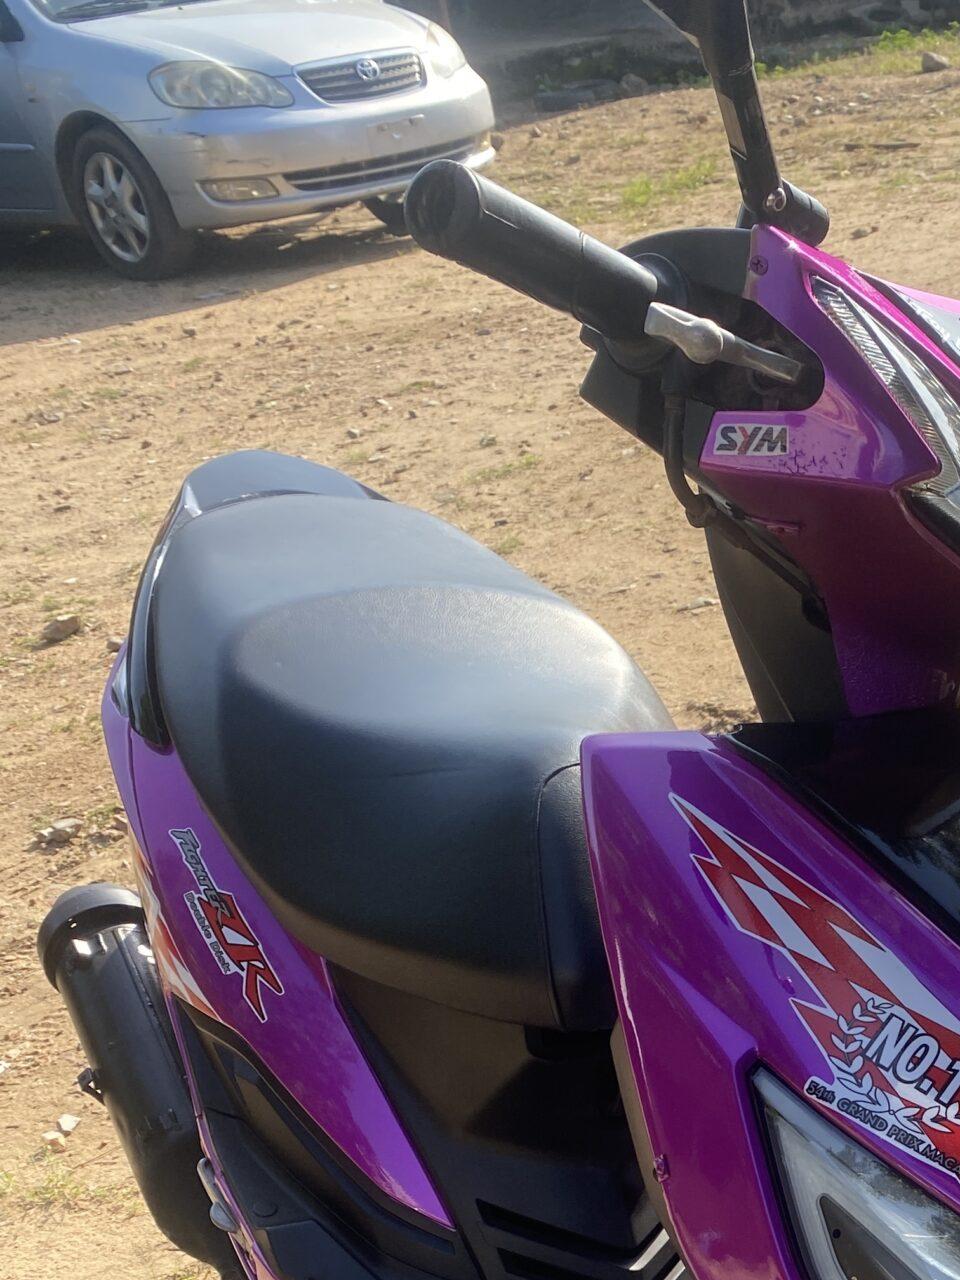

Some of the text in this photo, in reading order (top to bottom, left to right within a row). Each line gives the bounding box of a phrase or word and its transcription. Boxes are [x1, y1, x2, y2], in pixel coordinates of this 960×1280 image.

[717, 426, 786, 454] SYM
[169, 828, 235, 929] FIGHTER
[805, 1079, 837, 1105] 54th
[836, 1097, 888, 1132] GRAND
[887, 1123, 926, 1150] PRIX
